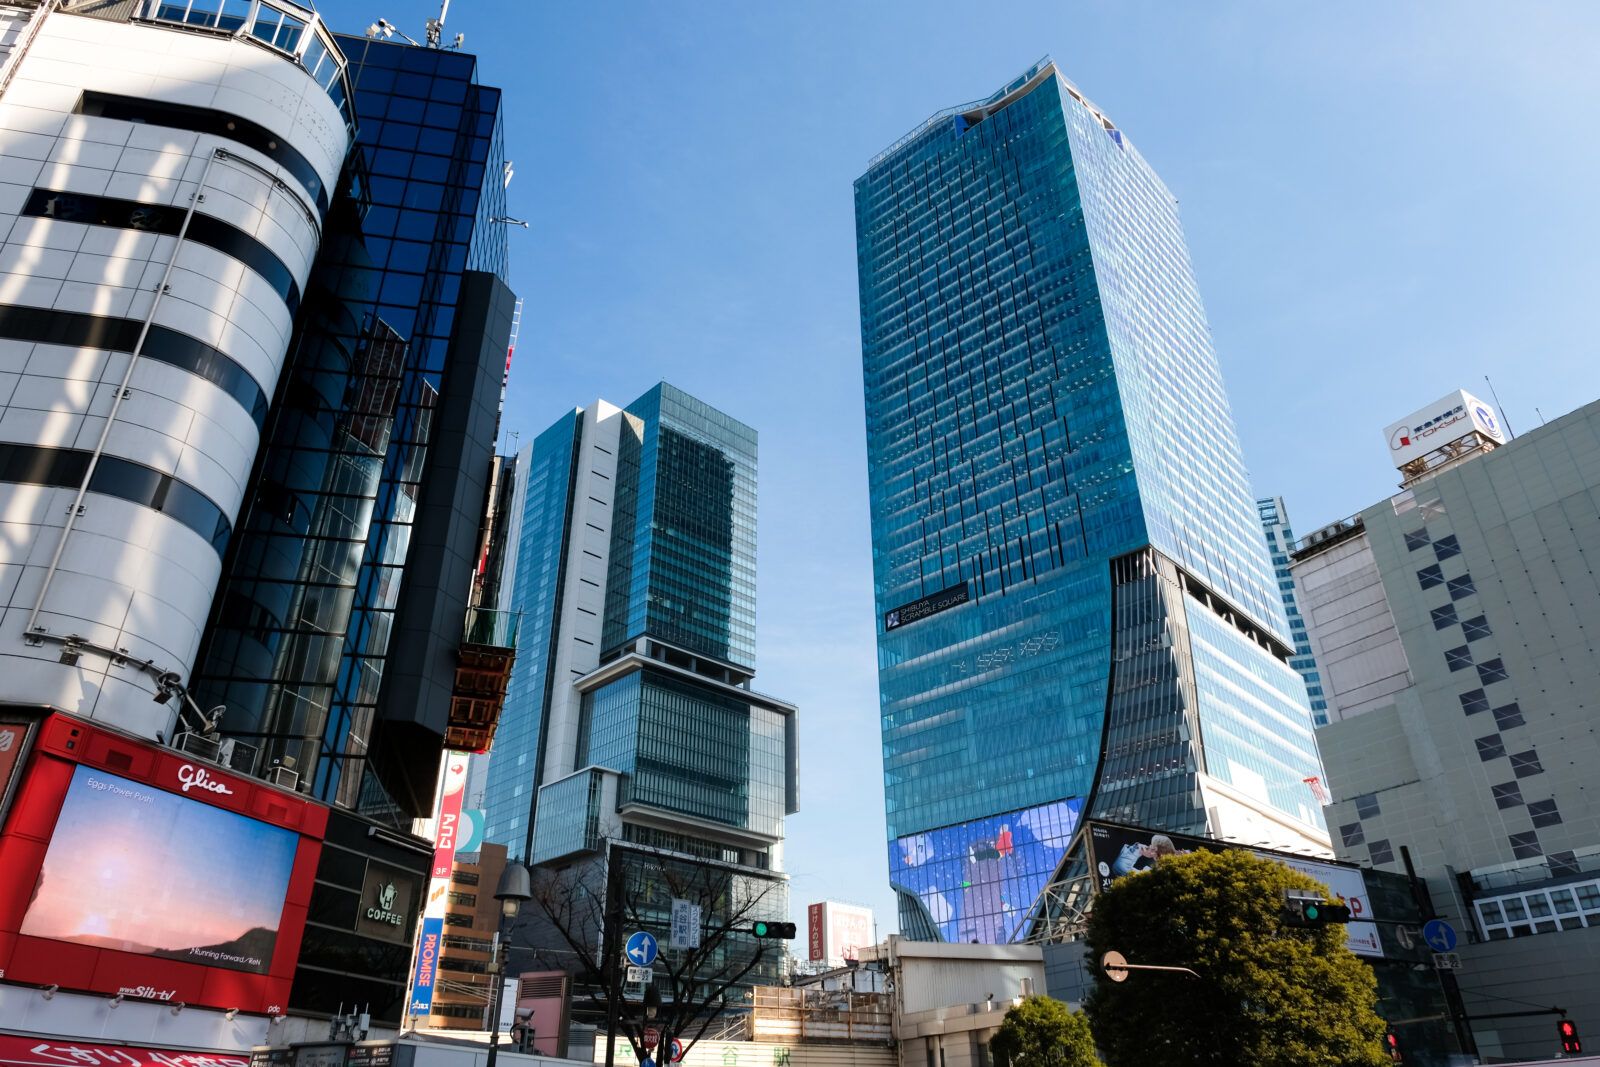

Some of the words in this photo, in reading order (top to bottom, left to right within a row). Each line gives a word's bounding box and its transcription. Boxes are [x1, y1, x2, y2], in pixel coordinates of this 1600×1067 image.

[1412, 411, 1467, 441] TOKYU
[900, 600, 930, 615] SHIBUYA
[900, 604, 937, 623] SCRAMBLE
[937, 593, 967, 609] SQUARE
[88, 777, 108, 792] Eggs
[108, 784, 133, 798] Power
[178, 764, 233, 792] Glico
[439, 813, 456, 849] アコム
[435, 867, 448, 875] 3F
[367, 907, 403, 925] COFFEE
[679, 903, 688, 946] 渋谷駅前
[194, 946, 220, 960] Running
[418, 933, 438, 987] PROMISE
